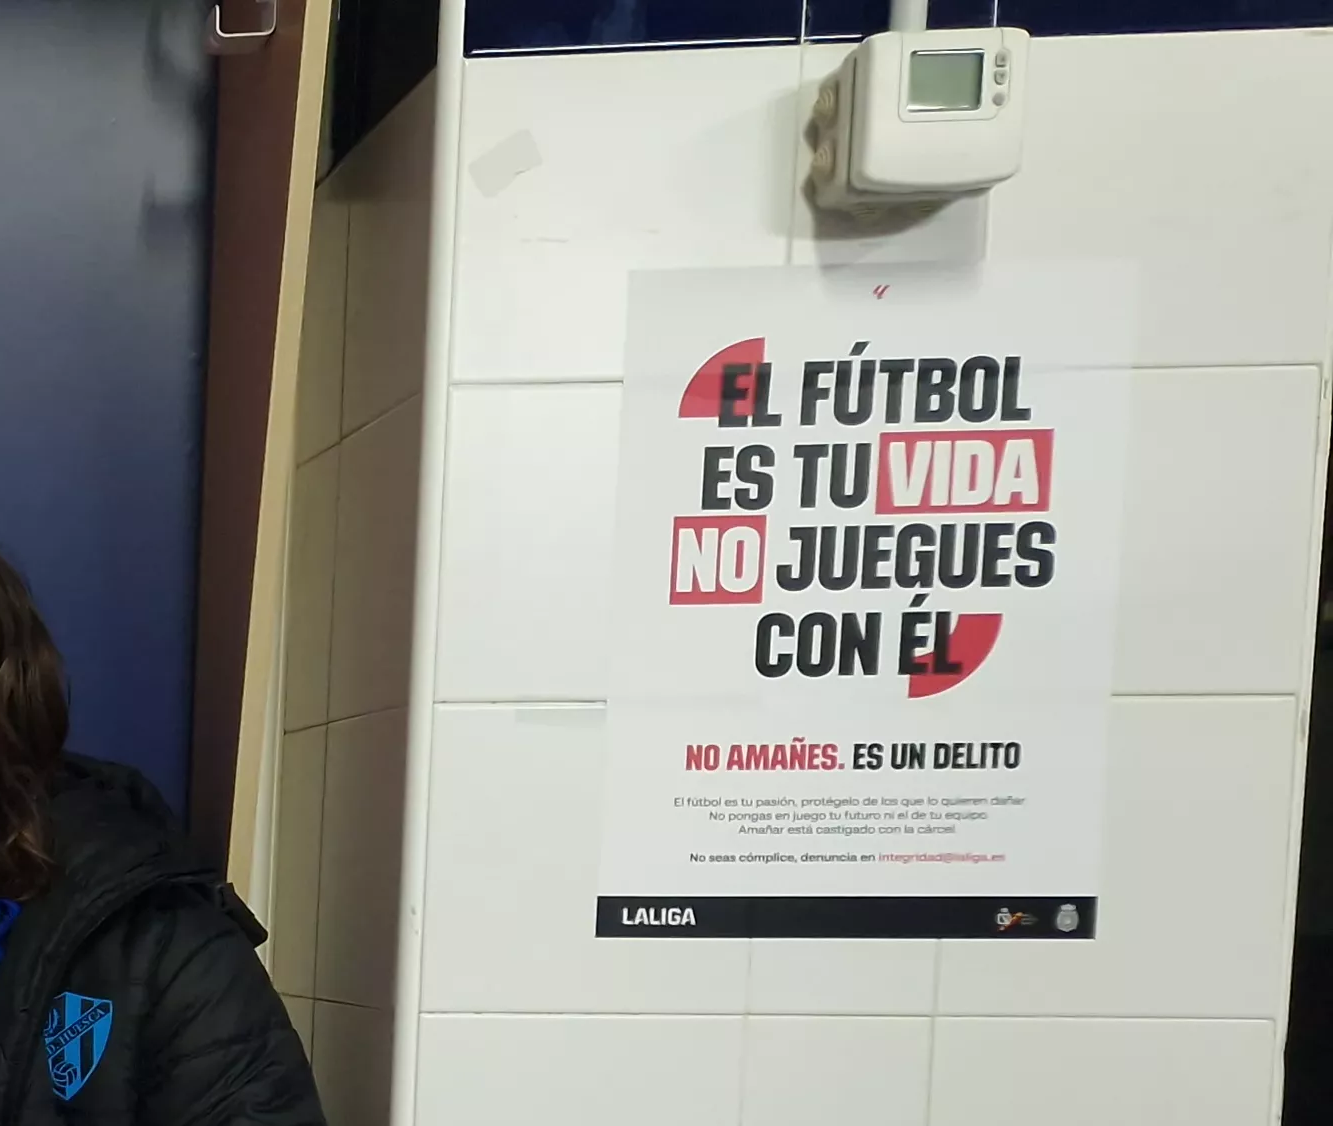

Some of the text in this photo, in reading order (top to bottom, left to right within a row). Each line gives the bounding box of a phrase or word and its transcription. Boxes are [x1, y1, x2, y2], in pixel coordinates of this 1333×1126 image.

[718, 341, 1032, 428] EL FÚTBOL
[700, 437, 1039, 511] ES TU VIDA
[675, 520, 1057, 594] NO JUEGUES
[755, 594, 963, 678] CON ÉL
[685, 737, 1021, 770] NO AMAÑES. ES UN DELITO
[674, 797, 684, 807] El
[687, 797, 722, 807] fútbol
[741, 798, 753, 807] tu
[756, 797, 798, 809] pasión,
[801, 797, 860, 809] protégelo
[863, 797, 878, 806] de
[881, 797, 898, 806] los
[900, 799, 925, 808] que
[928, 797, 939, 806] lo
[709, 811, 725, 820] No
[728, 813, 772, 823] pongas
[792, 811, 826, 822] juego
[829, 811, 841, 820] tu
[844, 810, 881, 820] futuro
[884, 810, 894, 819] ni
[897, 810, 908, 819] el
[911, 810, 926, 819] de
[930, 810, 942, 819] tu
[738, 825, 784, 834] Amañar
[787, 825, 813, 834] está
[816, 824, 876, 836] castigado
[904, 824, 914, 834] la
[690, 853, 706, 862] No
[709, 854, 736, 862] seas
[739, 852, 798, 864] cómplice,
[800, 852, 858, 862] denuncia
[860, 854, 875, 862] en
[622, 906, 696, 926] LALIGA
